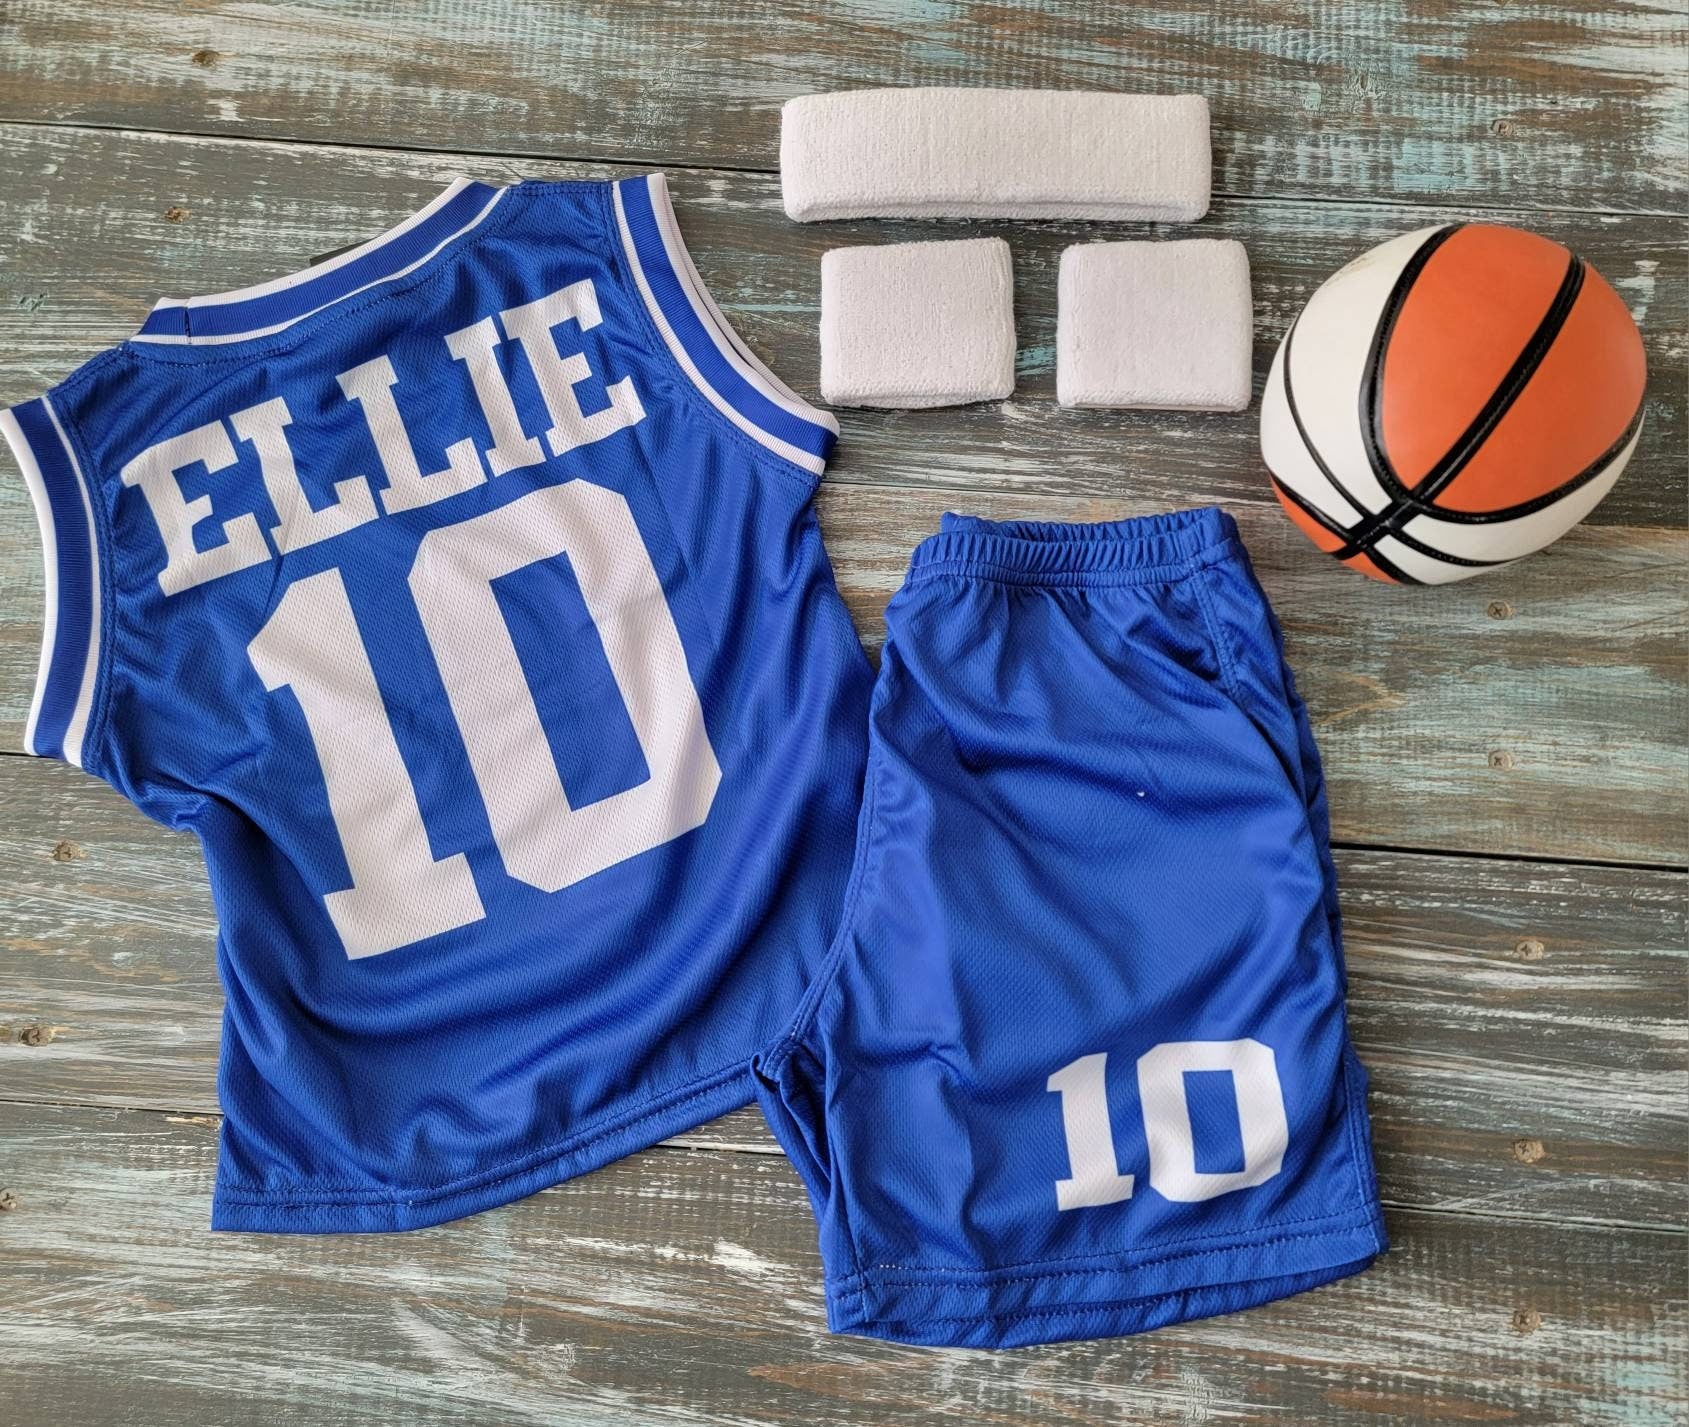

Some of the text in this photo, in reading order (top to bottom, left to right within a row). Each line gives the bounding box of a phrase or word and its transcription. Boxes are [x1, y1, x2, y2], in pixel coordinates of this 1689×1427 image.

[120, 279, 646, 597] ELLIE
[246, 479, 723, 961] 10
[1047, 1039, 1289, 1212] 10
